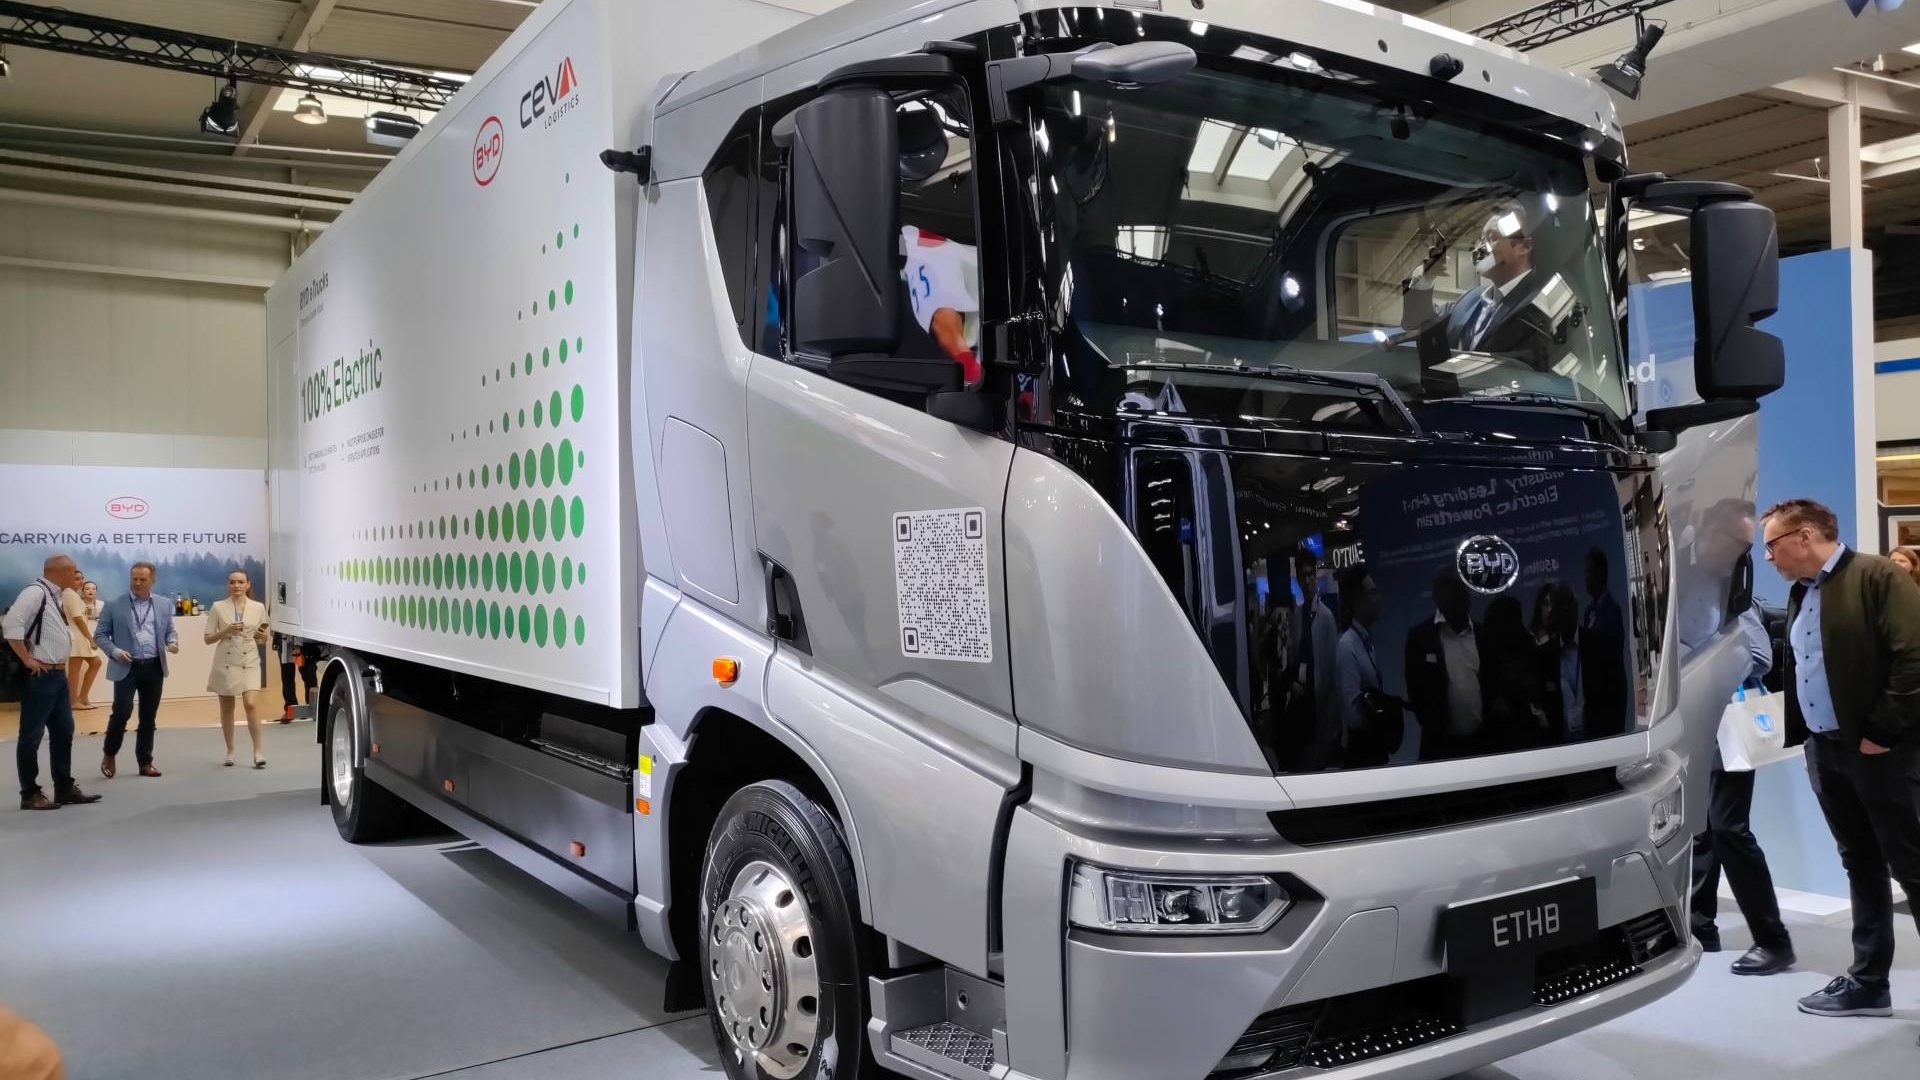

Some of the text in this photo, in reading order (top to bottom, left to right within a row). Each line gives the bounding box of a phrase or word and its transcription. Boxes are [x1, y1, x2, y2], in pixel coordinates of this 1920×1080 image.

[544, 94, 579, 129] LOGISTICS
[476, 133, 500, 170] BYD
[301, 339, 382, 424] 100% Electric
[0, 532, 248, 544] CARRYING A BETTER FUTURE
[1465, 552, 1515, 575] BYD
